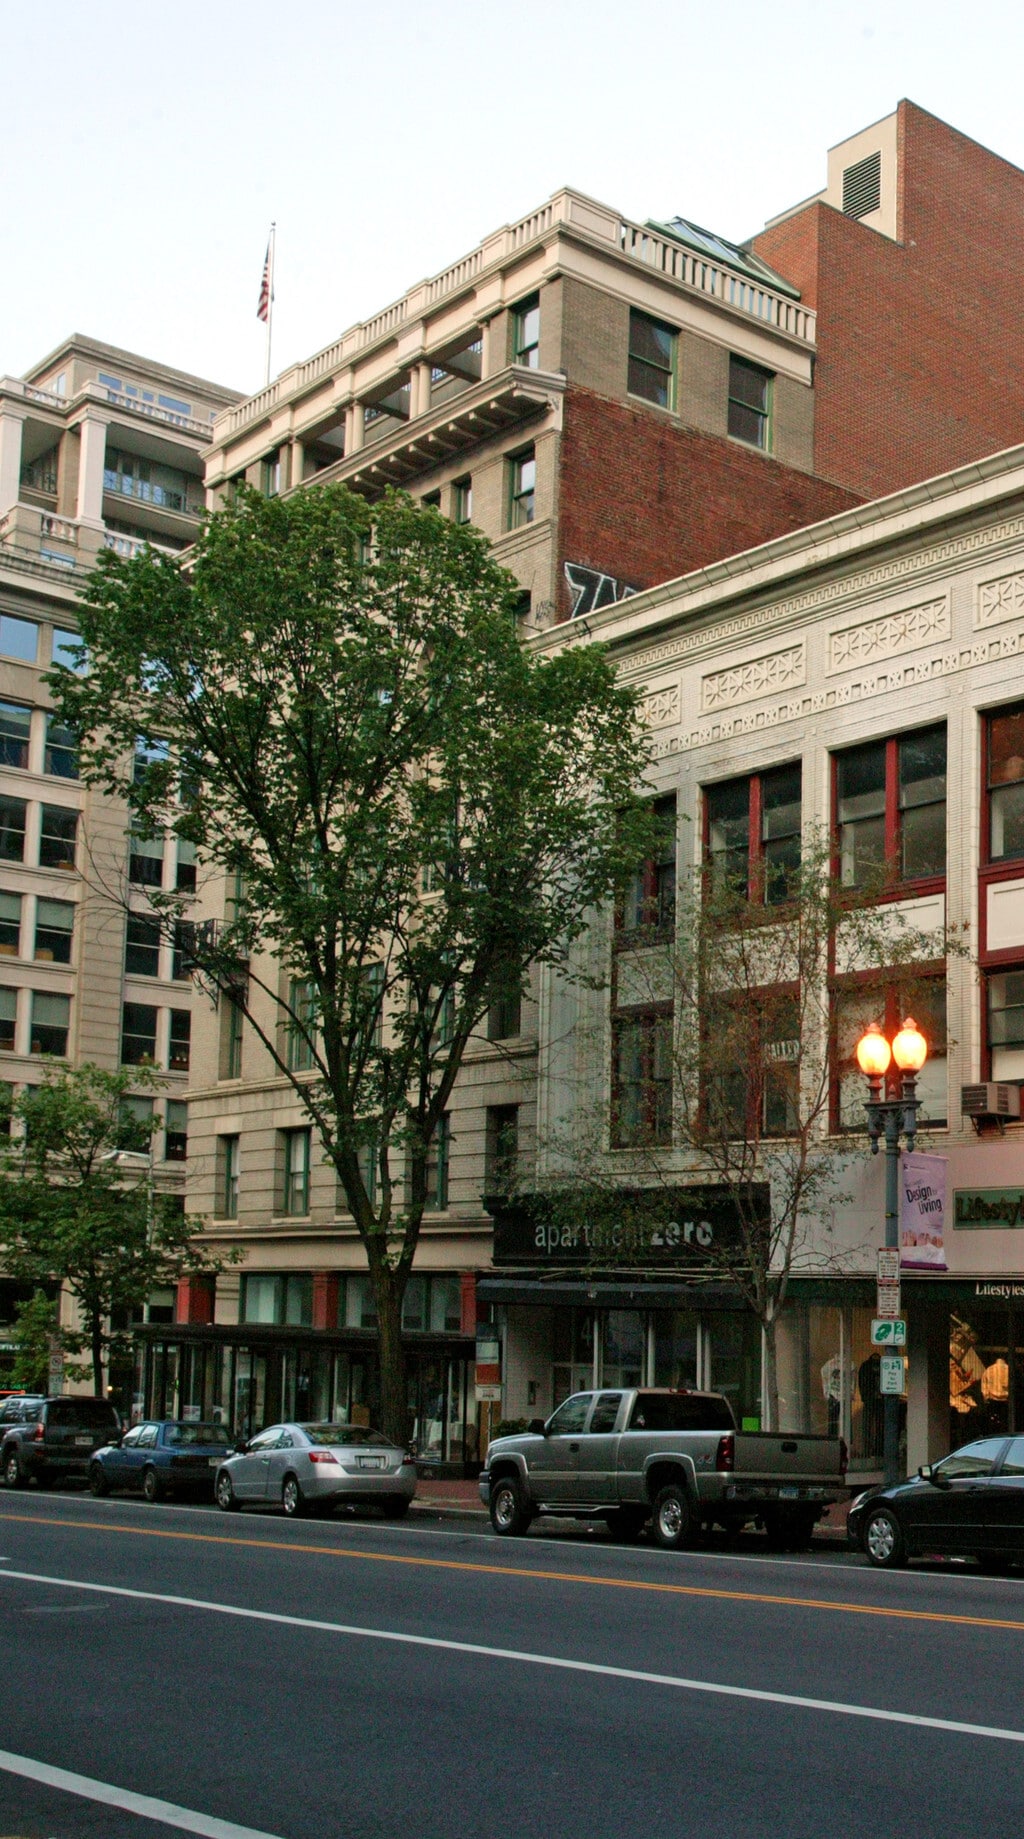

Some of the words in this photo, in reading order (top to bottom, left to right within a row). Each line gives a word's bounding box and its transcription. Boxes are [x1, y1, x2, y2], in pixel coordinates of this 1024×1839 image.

[906, 1186, 932, 1203] Design
[918, 1198, 942, 1214] Living
[534, 1223, 646, 1254] aparte
[896, 1323, 903, 1332] 2
